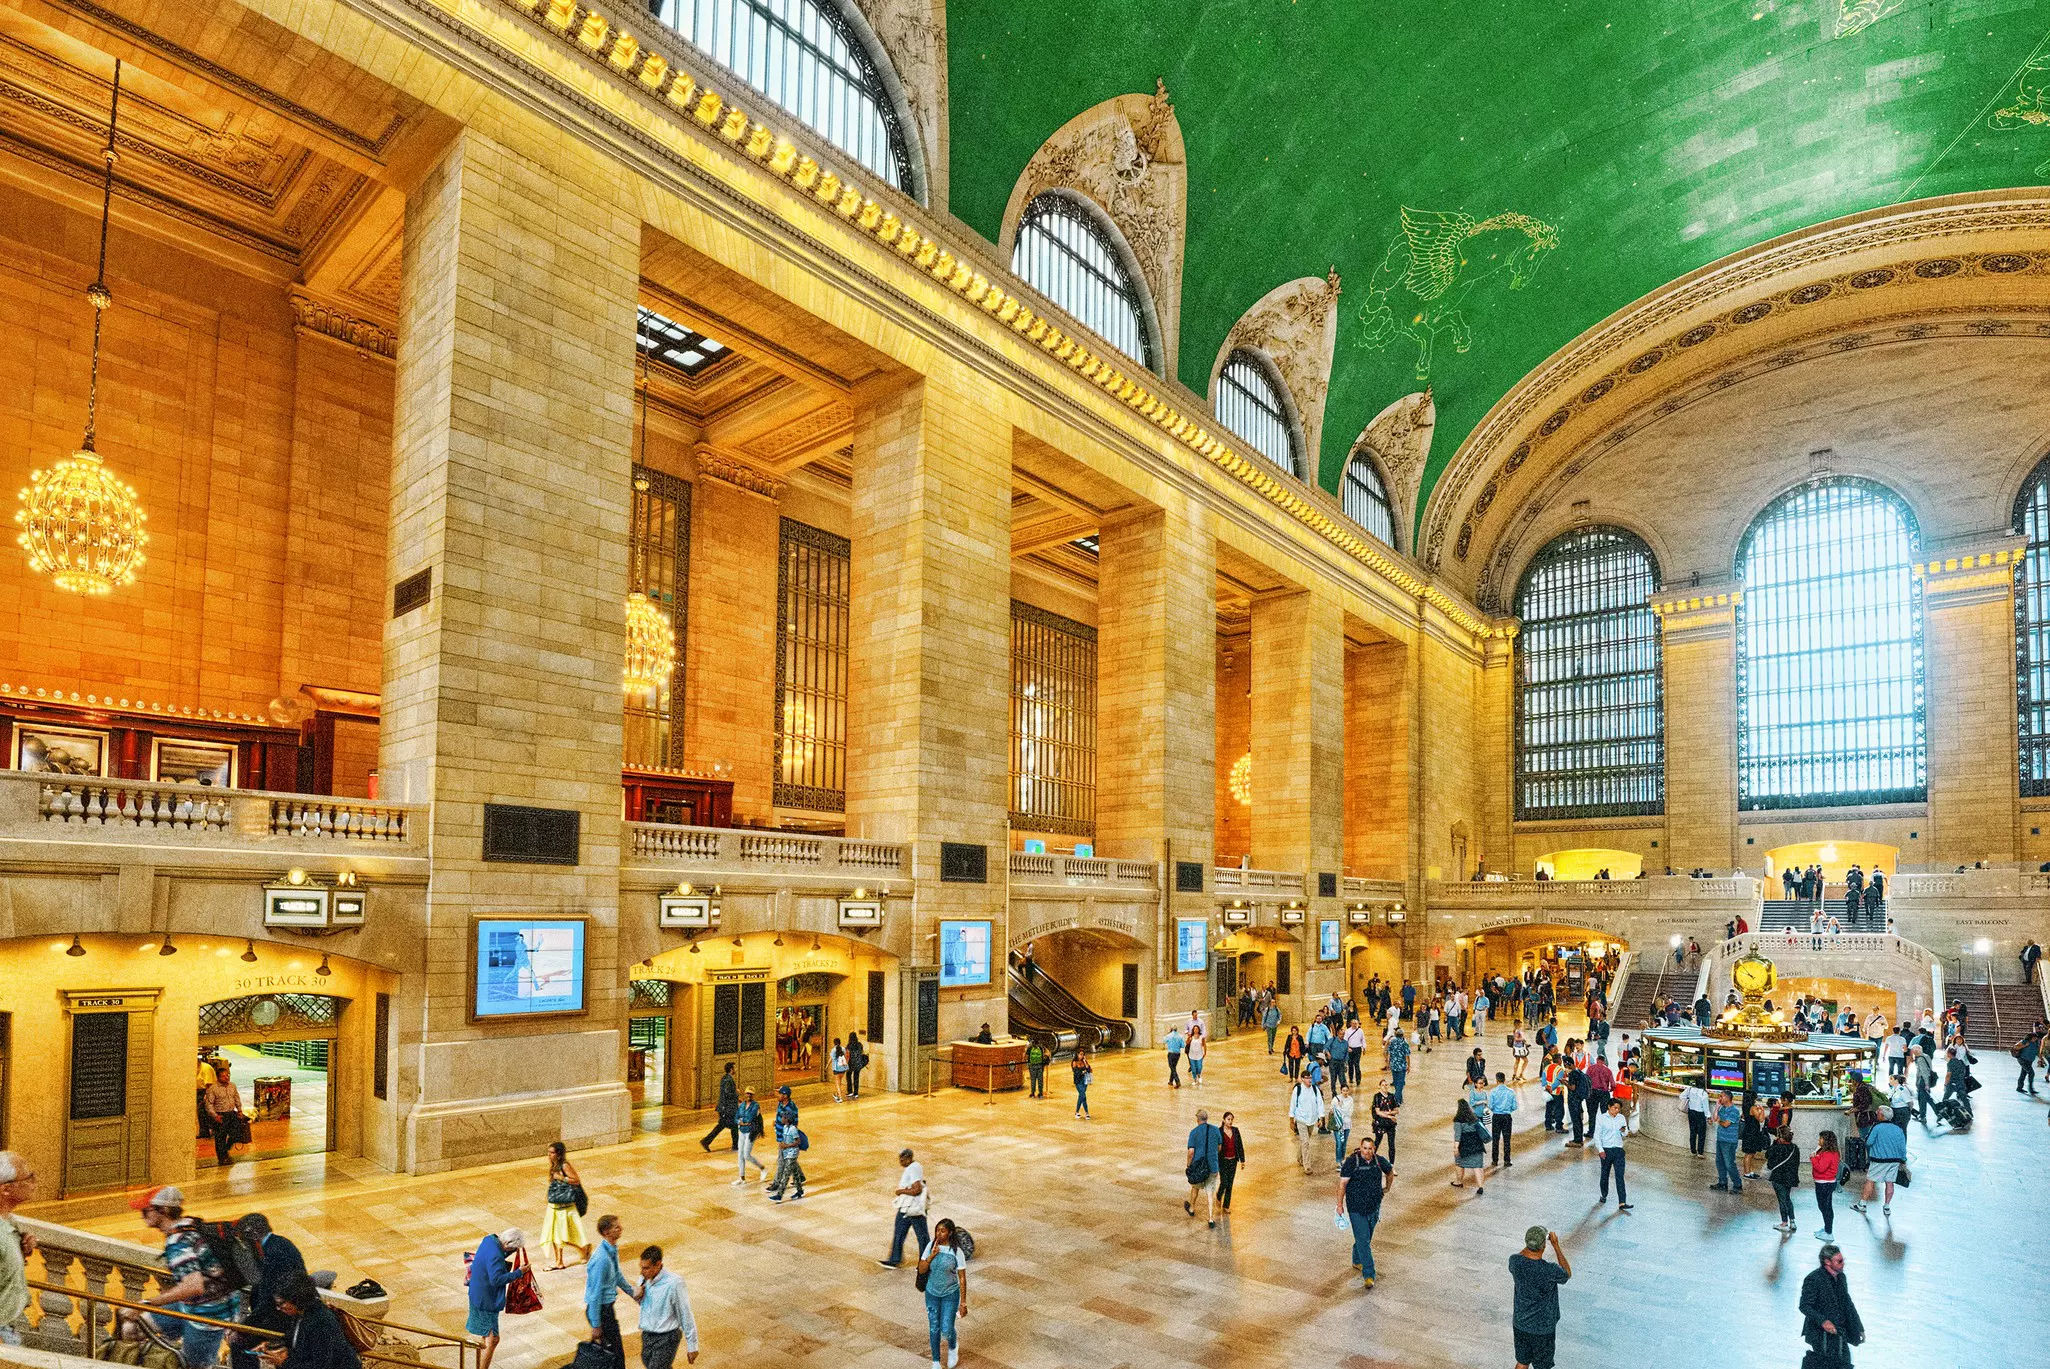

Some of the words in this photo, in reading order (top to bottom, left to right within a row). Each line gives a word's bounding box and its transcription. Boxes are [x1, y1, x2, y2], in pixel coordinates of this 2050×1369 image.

[1481, 919, 1504, 928] TRACKS
[1549, 916, 1591, 928] LEXINGTON
[1008, 934, 1021, 948] THE
[1022, 922, 1050, 941] METLIFE
[802, 959, 830, 969] TRACKS
[631, 964, 664, 975] TRACK
[666, 965, 676, 975] 29
[1832, 972, 1855, 980] DINING
[235, 978, 252, 990] 30
[255, 975, 307, 987] TRACK
[311, 976, 328, 988] 30
[1737, 1024, 1776, 1033] Information
